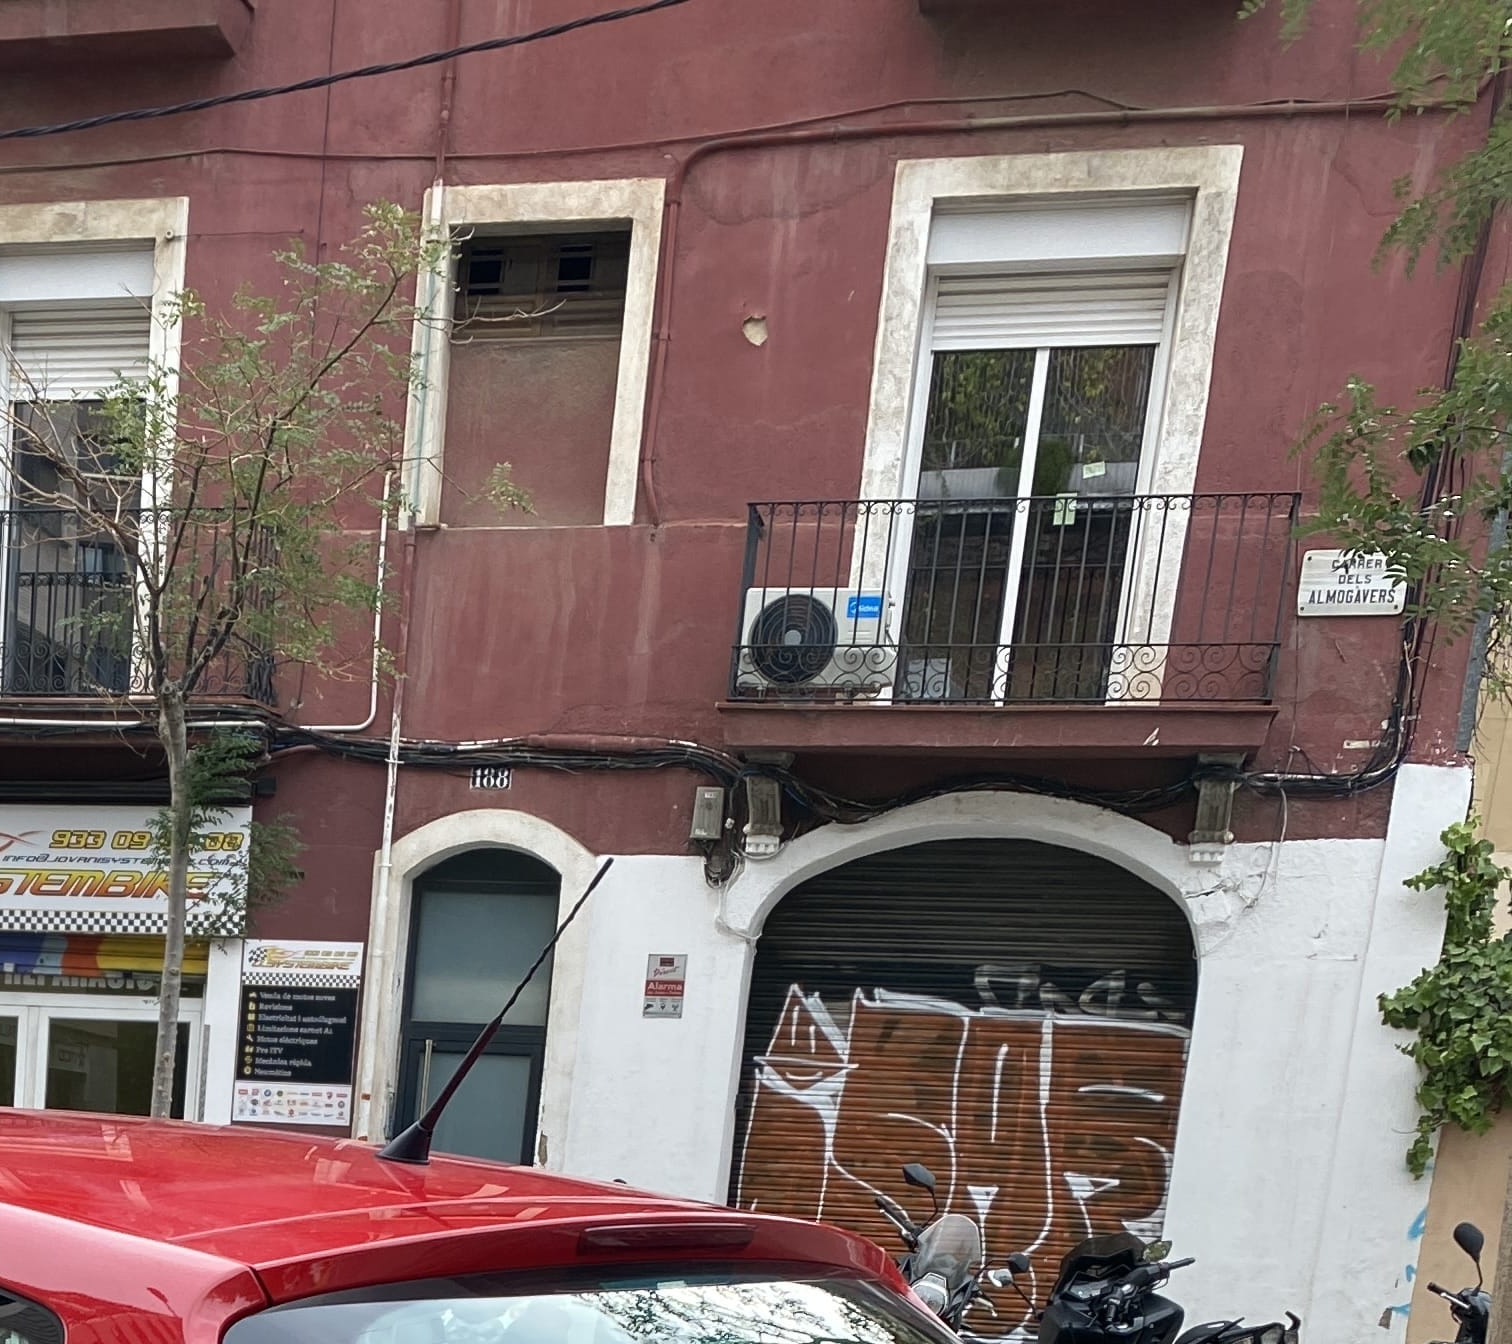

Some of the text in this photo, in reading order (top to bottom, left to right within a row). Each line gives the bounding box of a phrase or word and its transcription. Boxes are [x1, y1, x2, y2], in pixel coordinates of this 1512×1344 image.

[1338, 574, 1372, 584] DELS
[475, 768, 509, 788] 188
[49, 830, 107, 850] 933
[111, 831, 153, 851] 09
